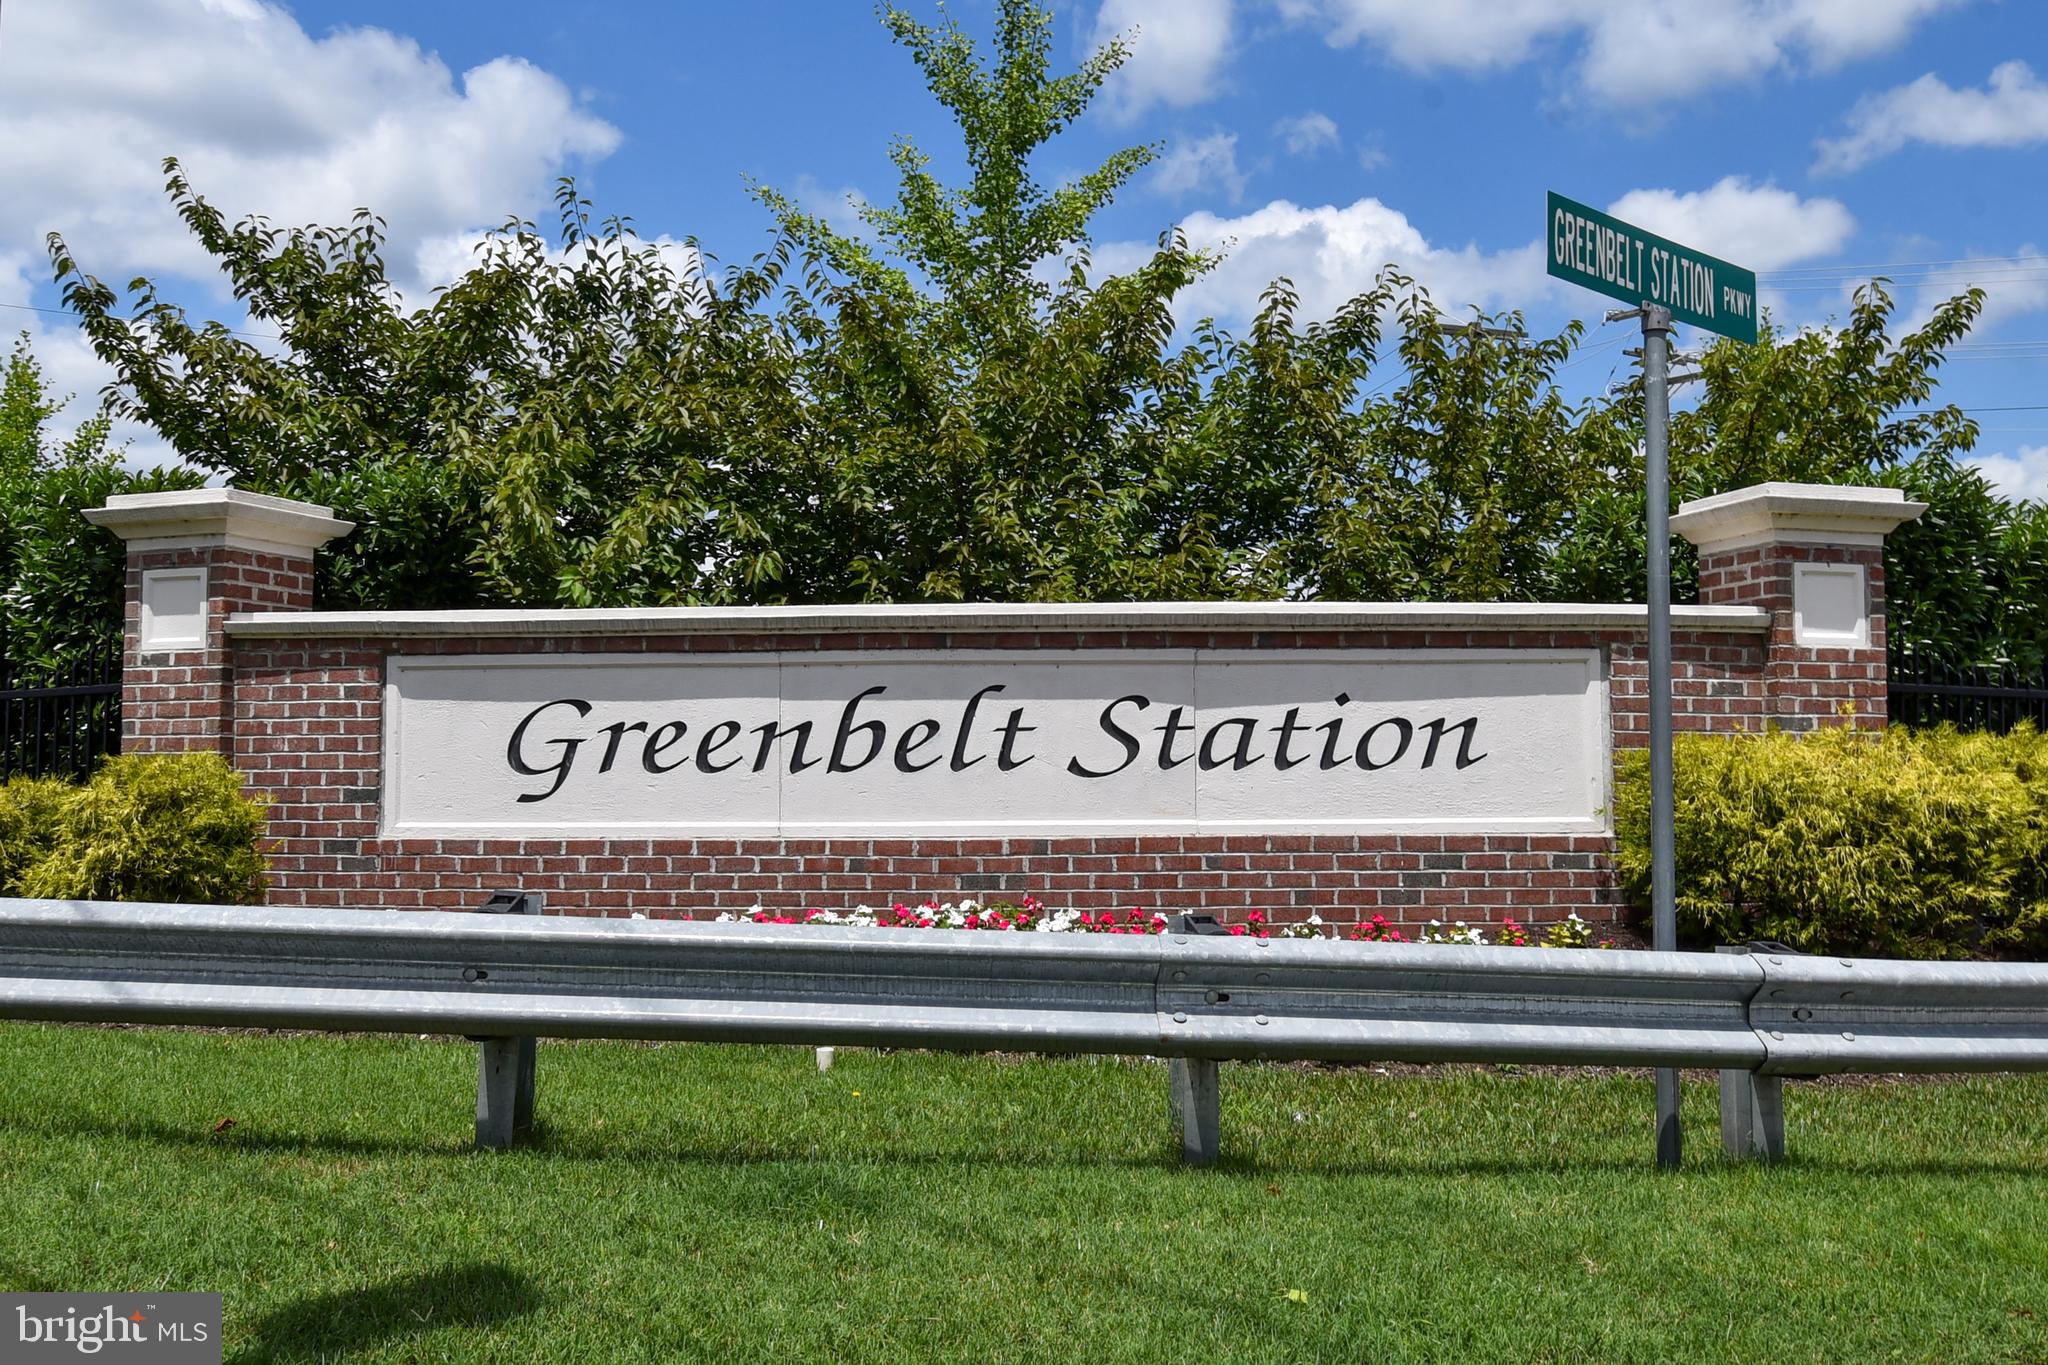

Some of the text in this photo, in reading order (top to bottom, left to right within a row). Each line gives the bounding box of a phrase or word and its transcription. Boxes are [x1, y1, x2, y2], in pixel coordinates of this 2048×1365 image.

[1554, 207, 1752, 319] GREENBELT STATION PKWY
[507, 684, 1488, 803] Greenbelt Station
